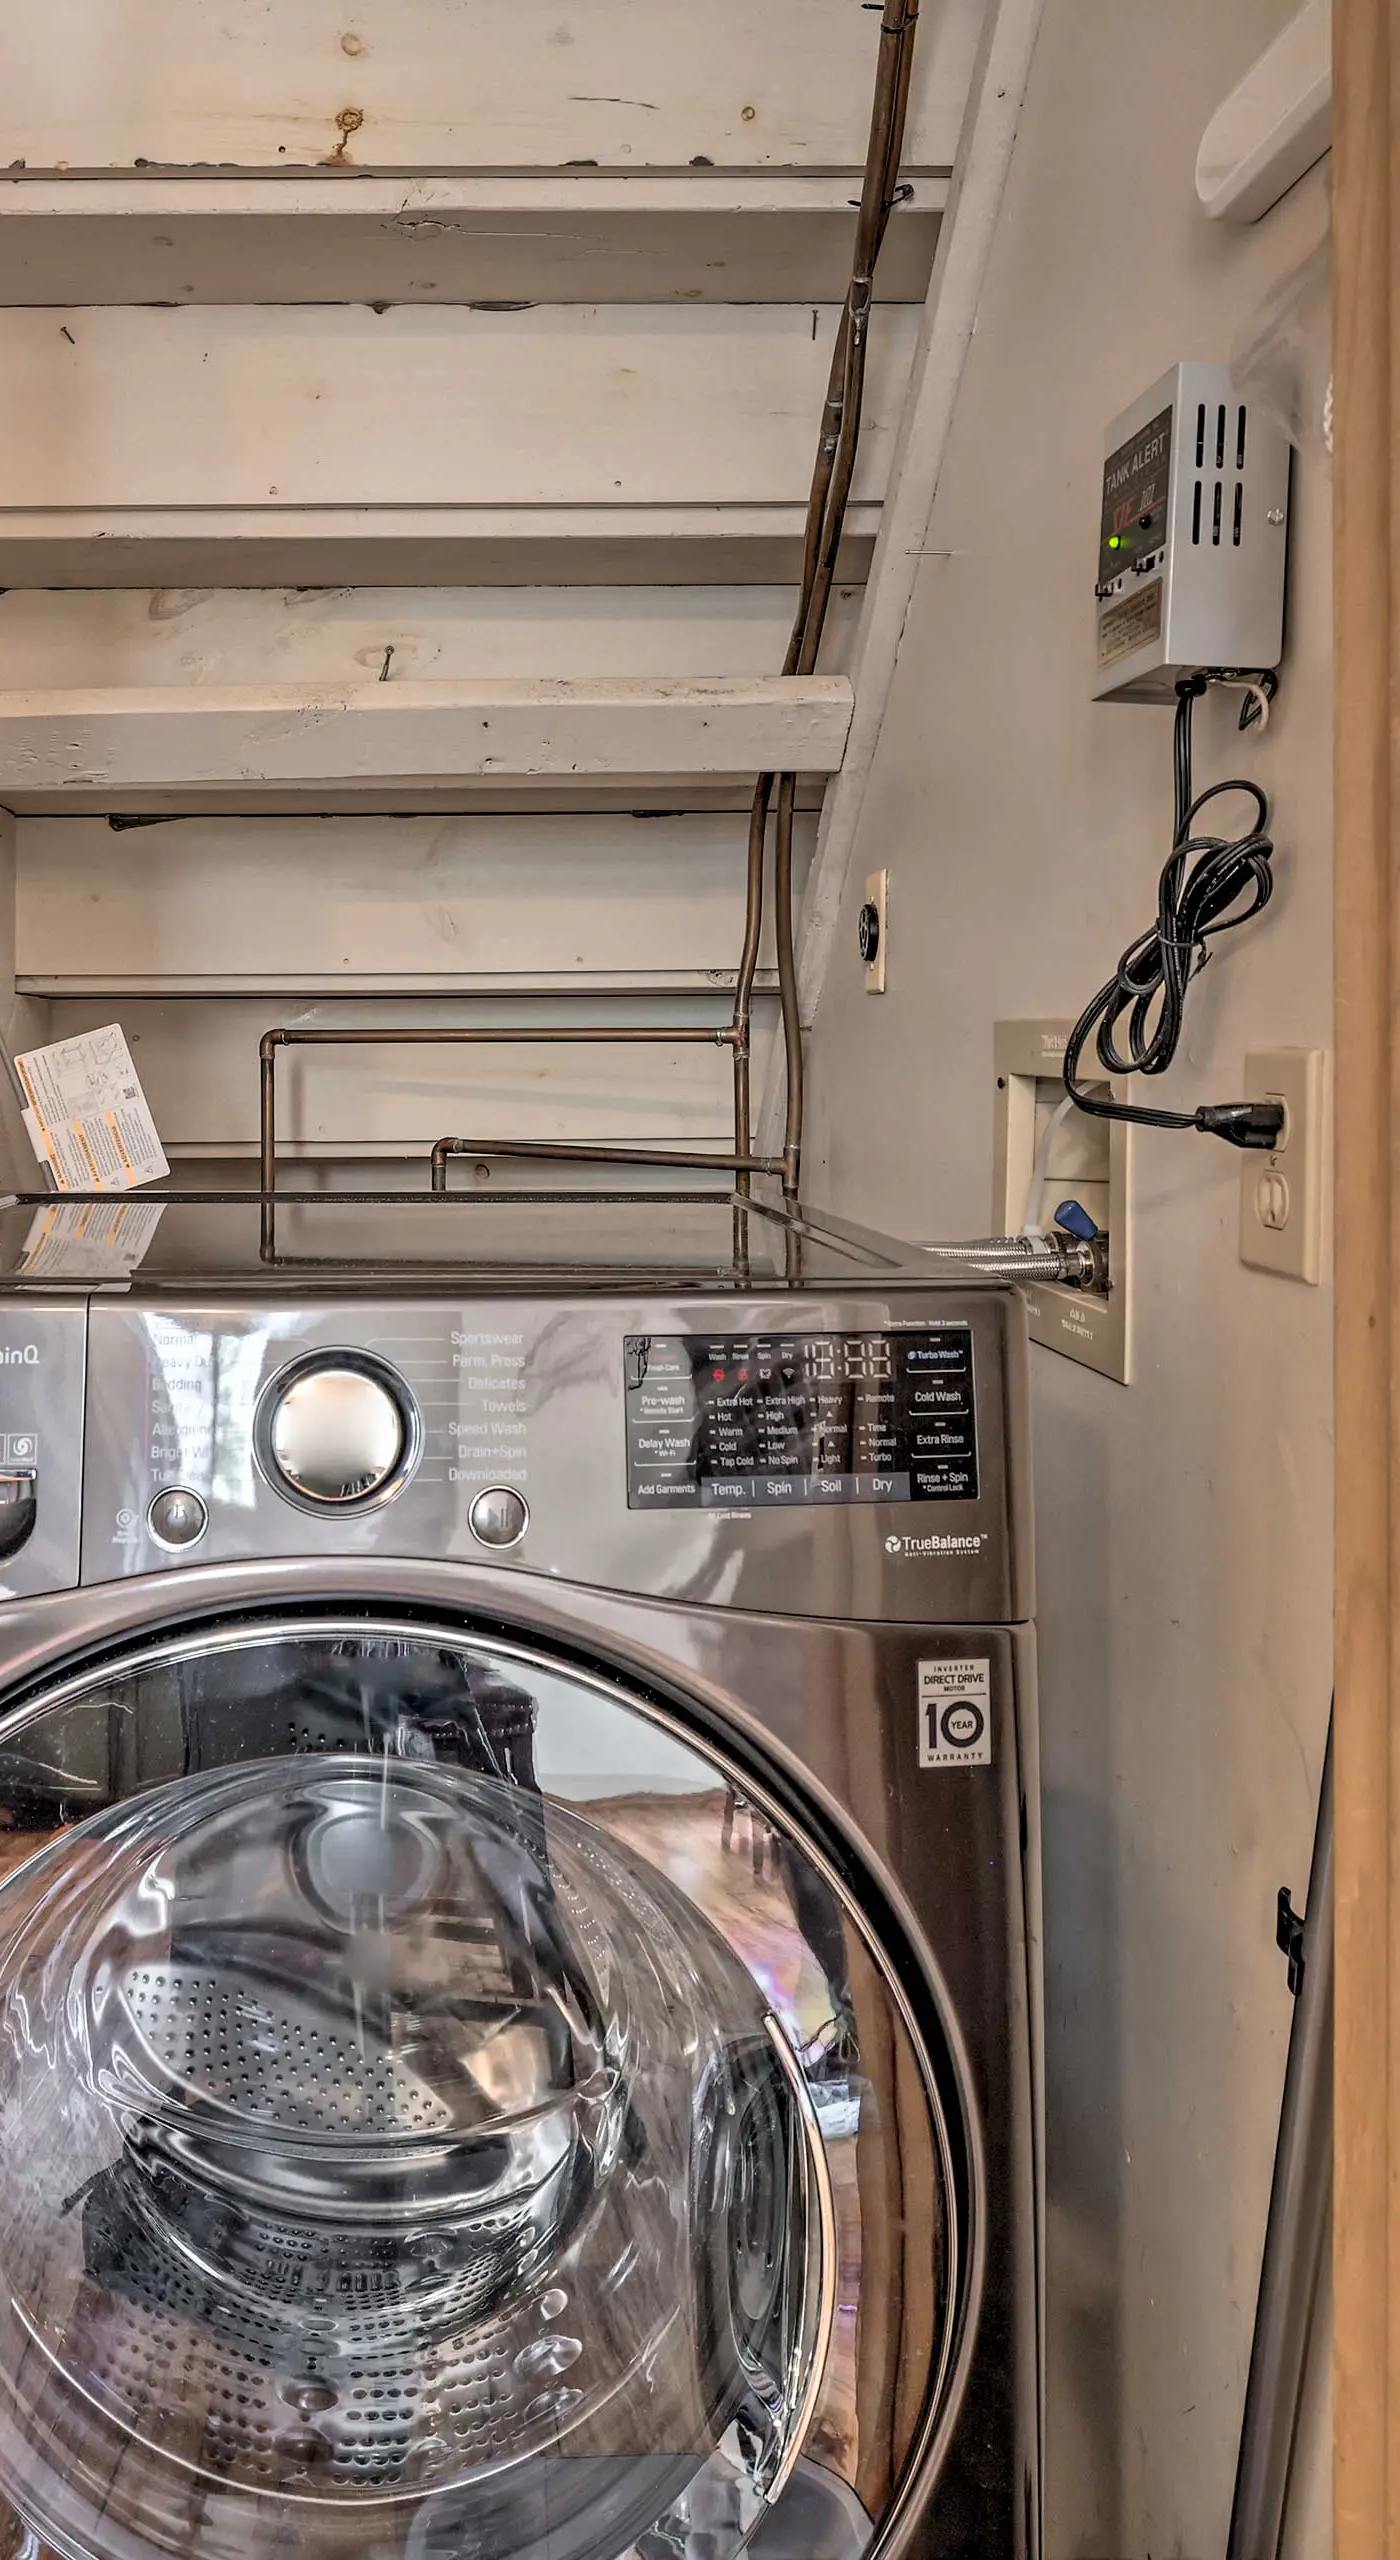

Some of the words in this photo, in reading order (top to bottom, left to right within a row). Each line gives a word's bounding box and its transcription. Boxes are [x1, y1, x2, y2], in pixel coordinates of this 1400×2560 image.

[1106, 465, 1130, 495] TANK
[1131, 432, 1166, 476] ALERT
[451, 1331, 524, 1347] Sportswear
[453, 1354, 487, 1367] Perm.
[491, 1354, 525, 1367] Press
[781, 1351, 793, 1360] Dry
[468, 1376, 526, 1390] Delicates
[641, 1395, 685, 1406] Pre-wash
[717, 1397, 738, 1407] Extra
[740, 1397, 753, 1406] Hot
[765, 1396, 786, 1406] Extra
[787, 1396, 805, 1407] High
[817, 1395, 843, 1405] Heavy
[915, 1392, 935, 1402] Cold
[936, 1391, 961, 1401] Wash
[482, 1399, 526, 1412] Towels
[717, 1412, 732, 1421] Hot
[766, 1411, 784, 1422] High
[449, 1422, 487, 1438] Speed
[491, 1422, 526, 1435] Wash
[719, 1427, 743, 1436] Warm
[767, 1426, 798, 1435] Medium
[821, 1424, 848, 1433] Normal
[868, 1423, 887, 1432] Time
[638, 1438, 663, 1449] Delay
[664, 1438, 690, 1448] Wash
[869, 1438, 897, 1447] Normal
[917, 1435, 940, 1445] Extra
[941, 1434, 964, 1444] Rinse
[719, 1442, 737, 1451] Cold
[768, 1441, 786, 1450] Low
[458, 1445, 526, 1459] Drain+Spin
[869, 1453, 892, 1462] Turbo
[721, 1457, 735, 1468] Tap
[736, 1456, 754, 1466] Cold
[768, 1456, 781, 1464] No
[781, 1455, 798, 1466] Spin
[821, 1454, 841, 1464] Light
[151, 1468, 172, 1482] Tu
[449, 1467, 526, 1481] Downloaded
[917, 1474, 940, 1483] Rinse
[949, 1473, 968, 1483] Spin
[638, 1484, 655, 1494] Add
[656, 1483, 696, 1494] Garments
[712, 1483, 746, 1497] Temp.
[767, 1481, 792, 1495] Spin
[821, 1480, 842, 1493] Soil
[872, 1478, 893, 1493] Dry
[934, 1664, 974, 1673] INVERTER
[924, 1674, 956, 1685] DIRECT
[957, 1673, 985, 1684] DRIVE
[925, 1700, 984, 1749] 10
[951, 1720, 973, 1730] YEAR
[927, 1752, 984, 1762] WARRANTY
